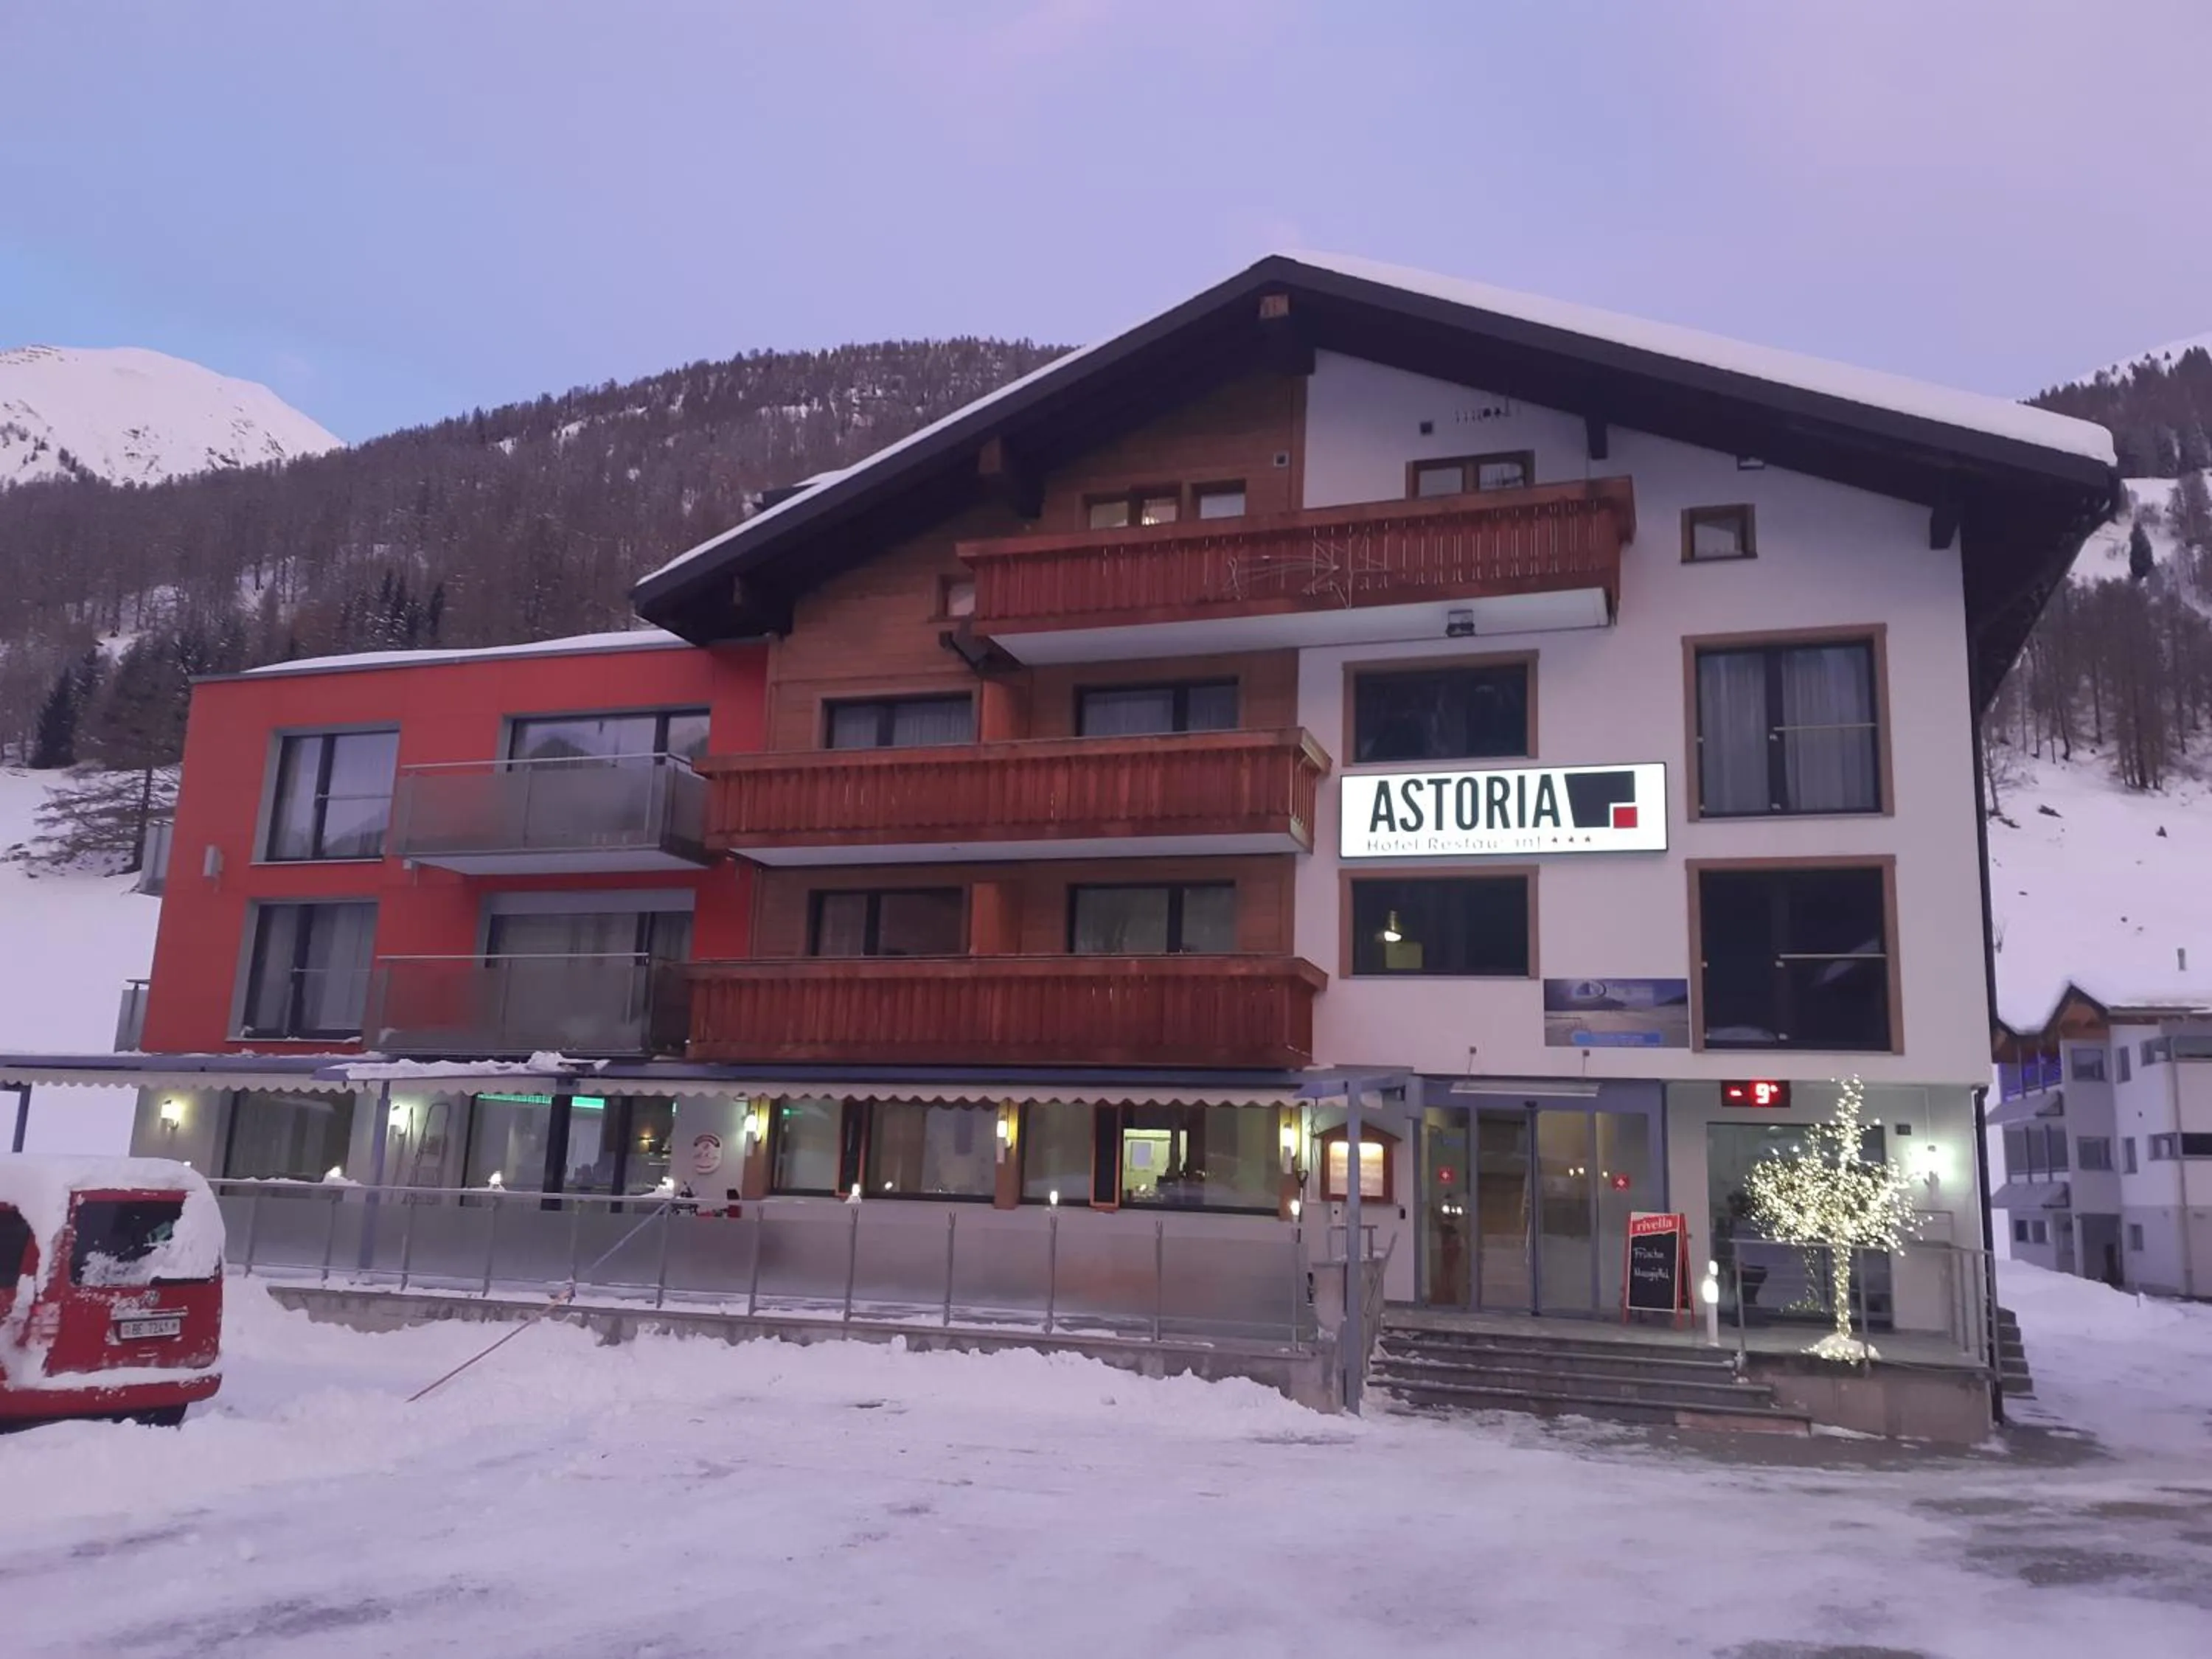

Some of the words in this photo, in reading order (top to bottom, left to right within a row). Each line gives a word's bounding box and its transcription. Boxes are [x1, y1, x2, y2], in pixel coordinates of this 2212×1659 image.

[1369, 773, 1562, 833] ASTORIA
[1367, 836, 1419, 852] Hotel
[1428, 835, 1541, 850] Restauant
[1637, 1217, 1672, 1231] rivella
